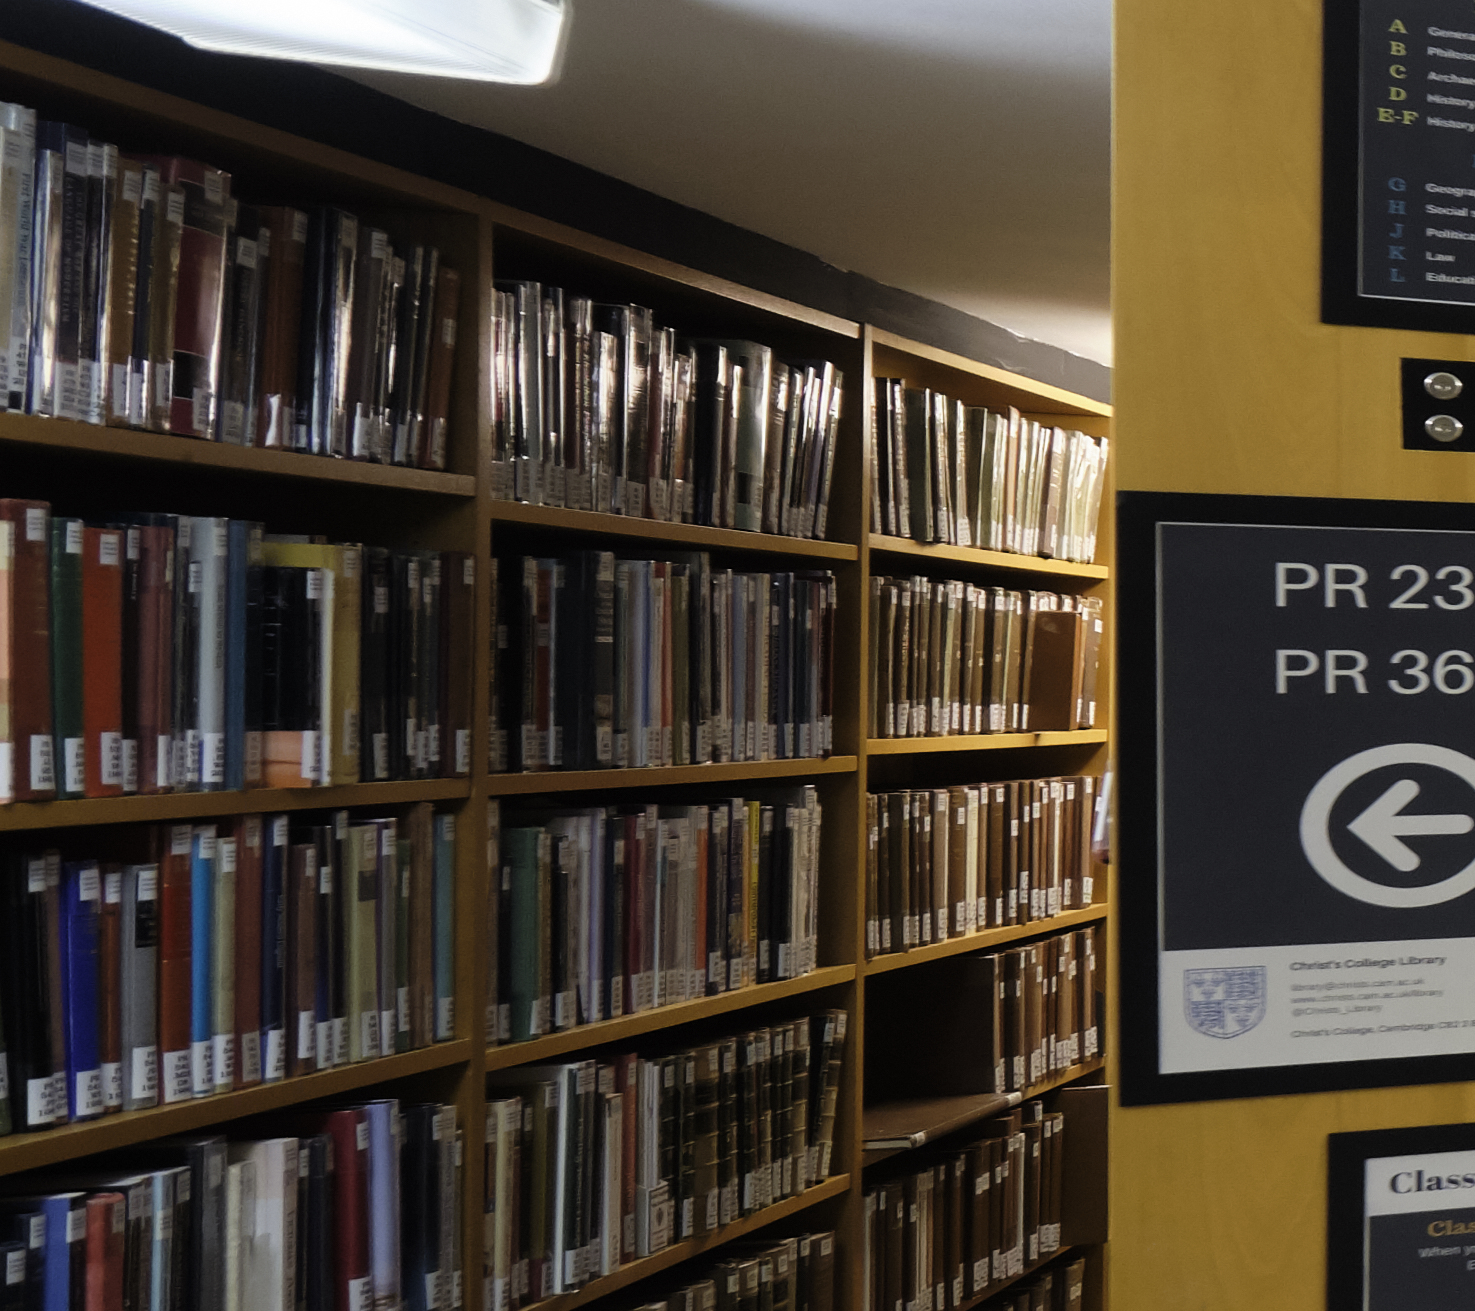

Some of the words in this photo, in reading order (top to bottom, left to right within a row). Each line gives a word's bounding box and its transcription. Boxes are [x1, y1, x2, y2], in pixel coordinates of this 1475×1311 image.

[1388, 19, 1408, 34] A
[1389, 41, 1407, 56] B
[1389, 64, 1407, 79] C
[1389, 87, 1407, 101] D
[1377, 107, 1420, 126] E-F
[1388, 177, 1407, 192] G
[1388, 200, 1407, 215] H
[1389, 223, 1405, 239] J
[1388, 245, 1407, 261] K
[1425, 251, 1456, 262] Law
[1390, 268, 1406, 282] L
[1274, 562, 1369, 610] PR
[1274, 649, 1369, 695] PR
